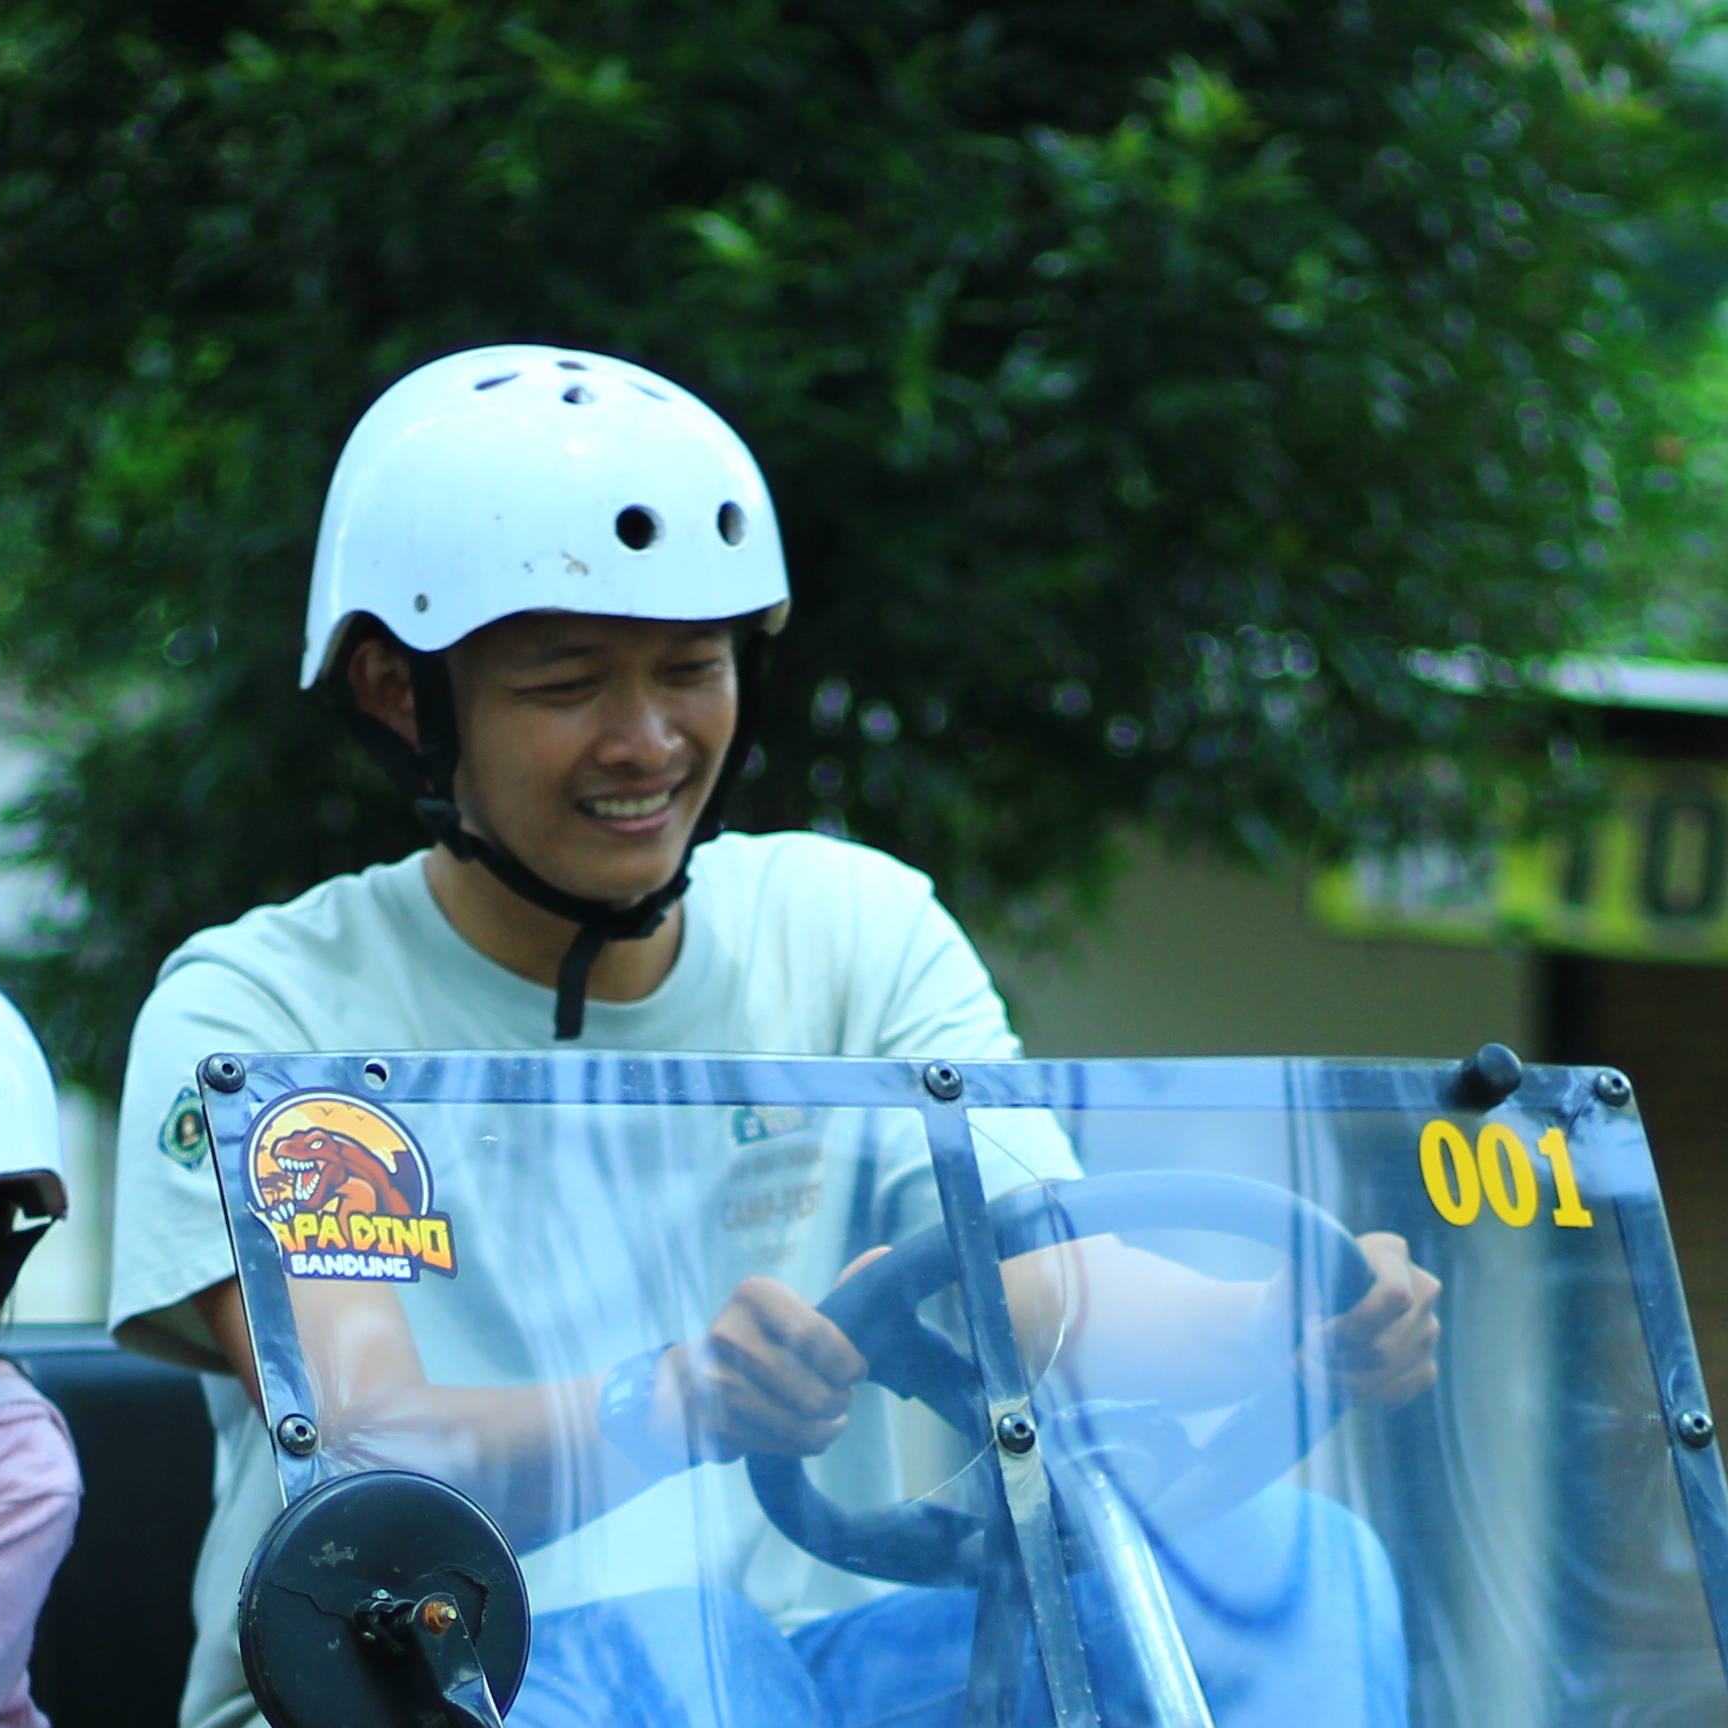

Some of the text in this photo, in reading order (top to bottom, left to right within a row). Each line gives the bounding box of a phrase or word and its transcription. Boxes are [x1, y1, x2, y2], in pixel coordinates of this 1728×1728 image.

[1419, 1118, 1594, 1230] 001
[256, 1212, 453, 1269] APA DINO
[290, 1252, 412, 1279] BANDUNG
